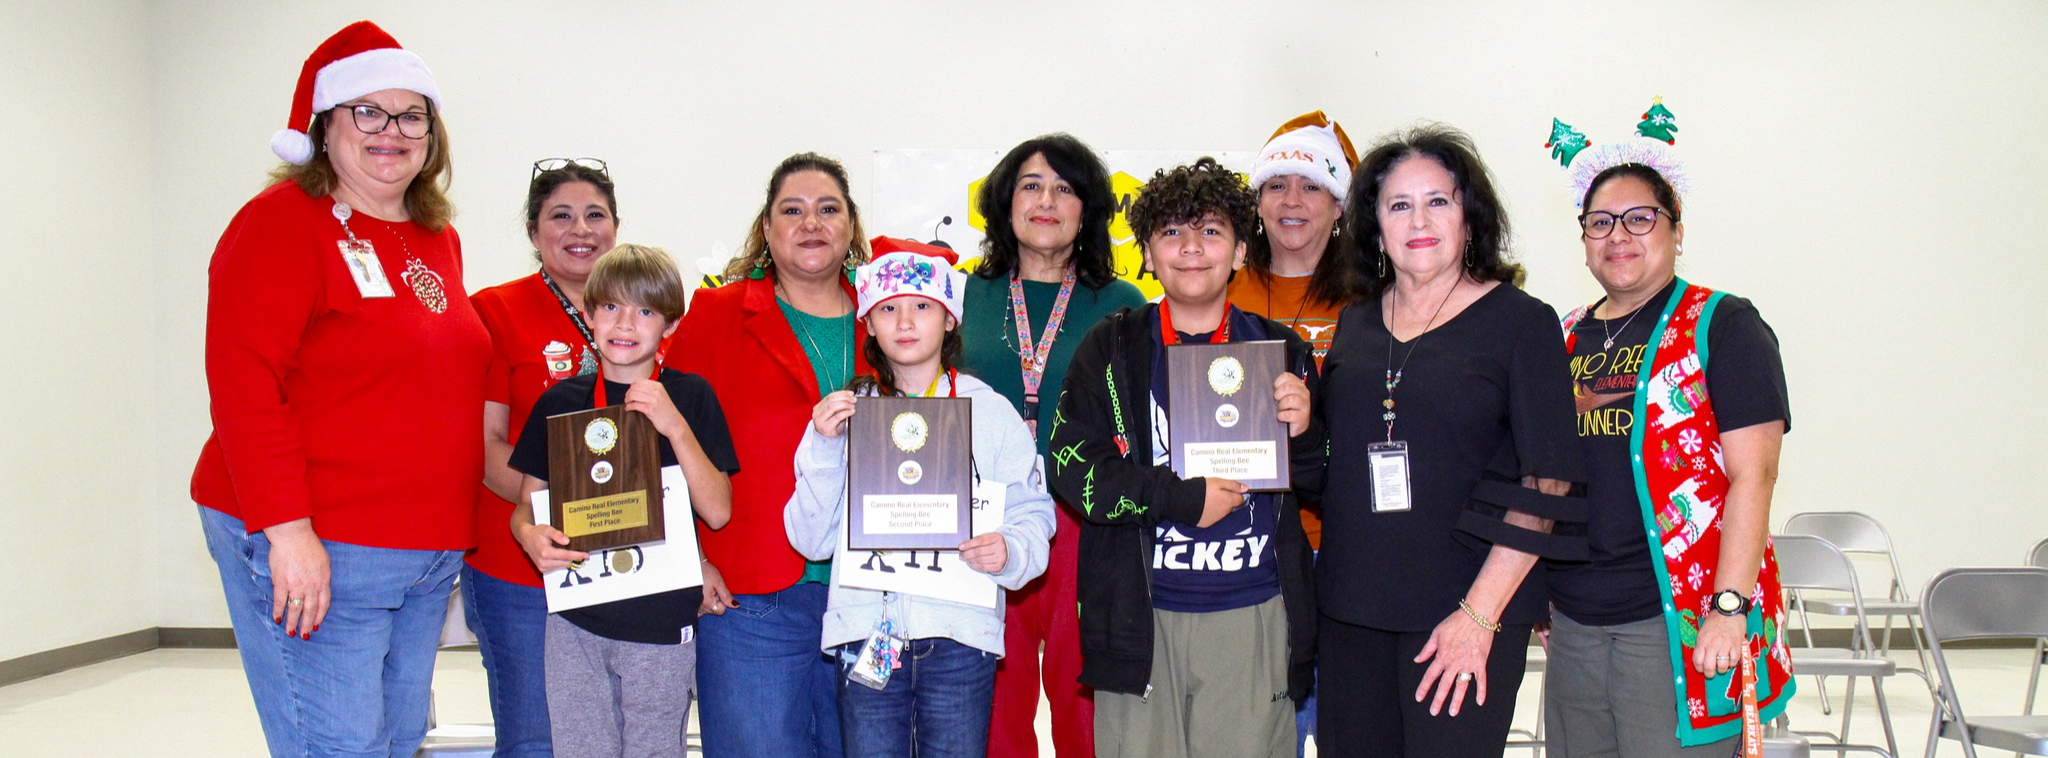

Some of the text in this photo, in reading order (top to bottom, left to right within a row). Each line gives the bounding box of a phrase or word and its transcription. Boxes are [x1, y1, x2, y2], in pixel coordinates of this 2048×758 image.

[1593, 374, 1638, 391] ELEMENTA
[1576, 408, 1634, 437] UNNER
[1190, 448, 1215, 456] Camino
[1232, 447, 1268, 455] Elementary
[1210, 457, 1236, 465] Spelling
[568, 497, 640, 514] Camino Real Elementary
[870, 501, 896, 509] Camino
[913, 501, 950, 509] Elementary
[586, 508, 623, 520] Spelling Bee
[890, 511, 917, 519] Spelling
[589, 518, 621, 528] First Place
[888, 520, 933, 528] Second Place
[1152, 534, 1269, 572] ICKEY
[1744, 704, 1758, 755] BEARKATS
